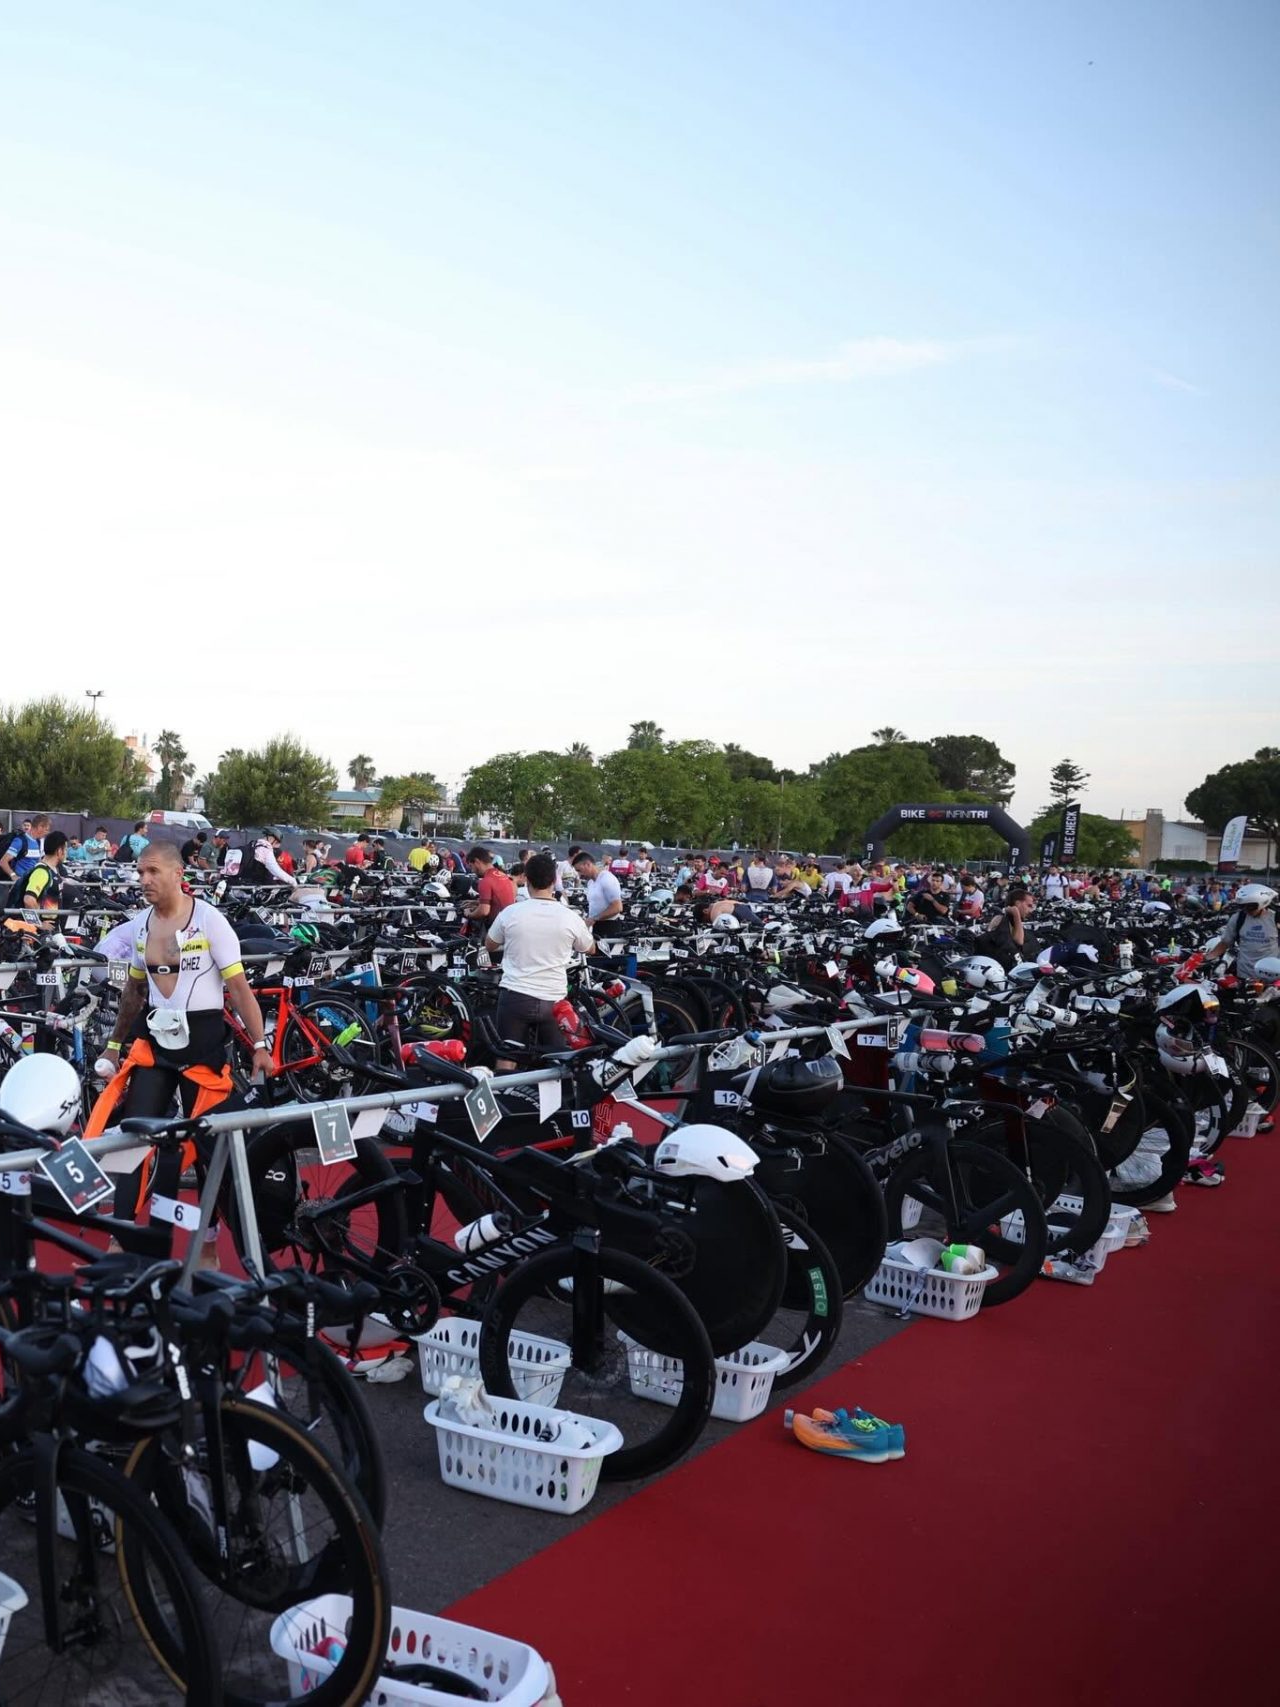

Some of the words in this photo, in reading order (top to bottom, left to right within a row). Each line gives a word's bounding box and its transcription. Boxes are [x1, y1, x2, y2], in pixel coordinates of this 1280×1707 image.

[901, 810, 926, 819] BIKE
[1065, 810, 1077, 836] CHECK
[1063, 836, 1075, 854] BIKE
[404, 957, 415, 968] 175
[39, 973, 57, 984] 168
[110, 968, 126, 982] 169
[862, 1036, 875, 1045] 17
[477, 1098, 487, 1116] 9
[721, 1092, 738, 1105] 12
[572, 1112, 590, 1126] 10
[327, 1121, 337, 1142] 7
[65, 1160, 85, 1183] 5
[1, 1173, 11, 1190] 5
[174, 1204, 184, 1222] 6
[447, 1226, 559, 1285] CANYON
